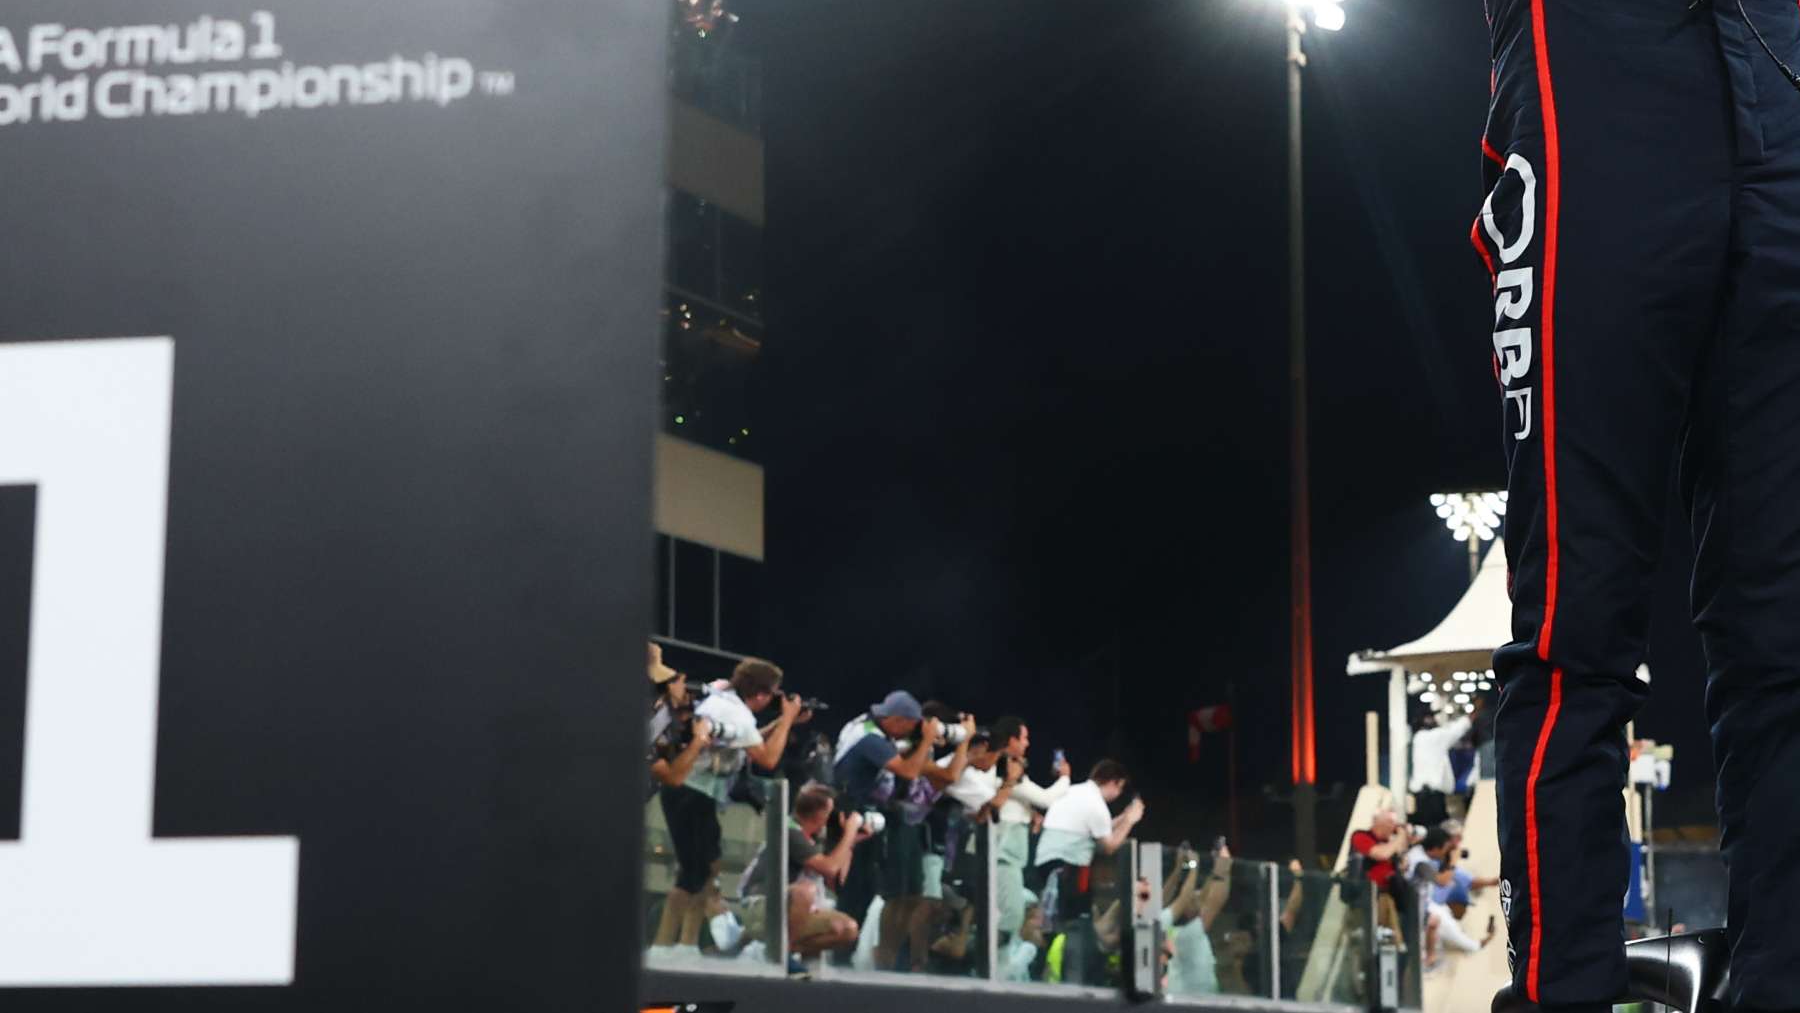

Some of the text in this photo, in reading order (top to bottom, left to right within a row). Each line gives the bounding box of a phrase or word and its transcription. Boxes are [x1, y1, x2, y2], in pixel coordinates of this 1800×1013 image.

[28, 14, 245, 72] Formula
[248, 10, 282, 59] 1
[0, 73, 88, 125] orld
[95, 51, 473, 119] Championship
[0, 336, 300, 987] 1
